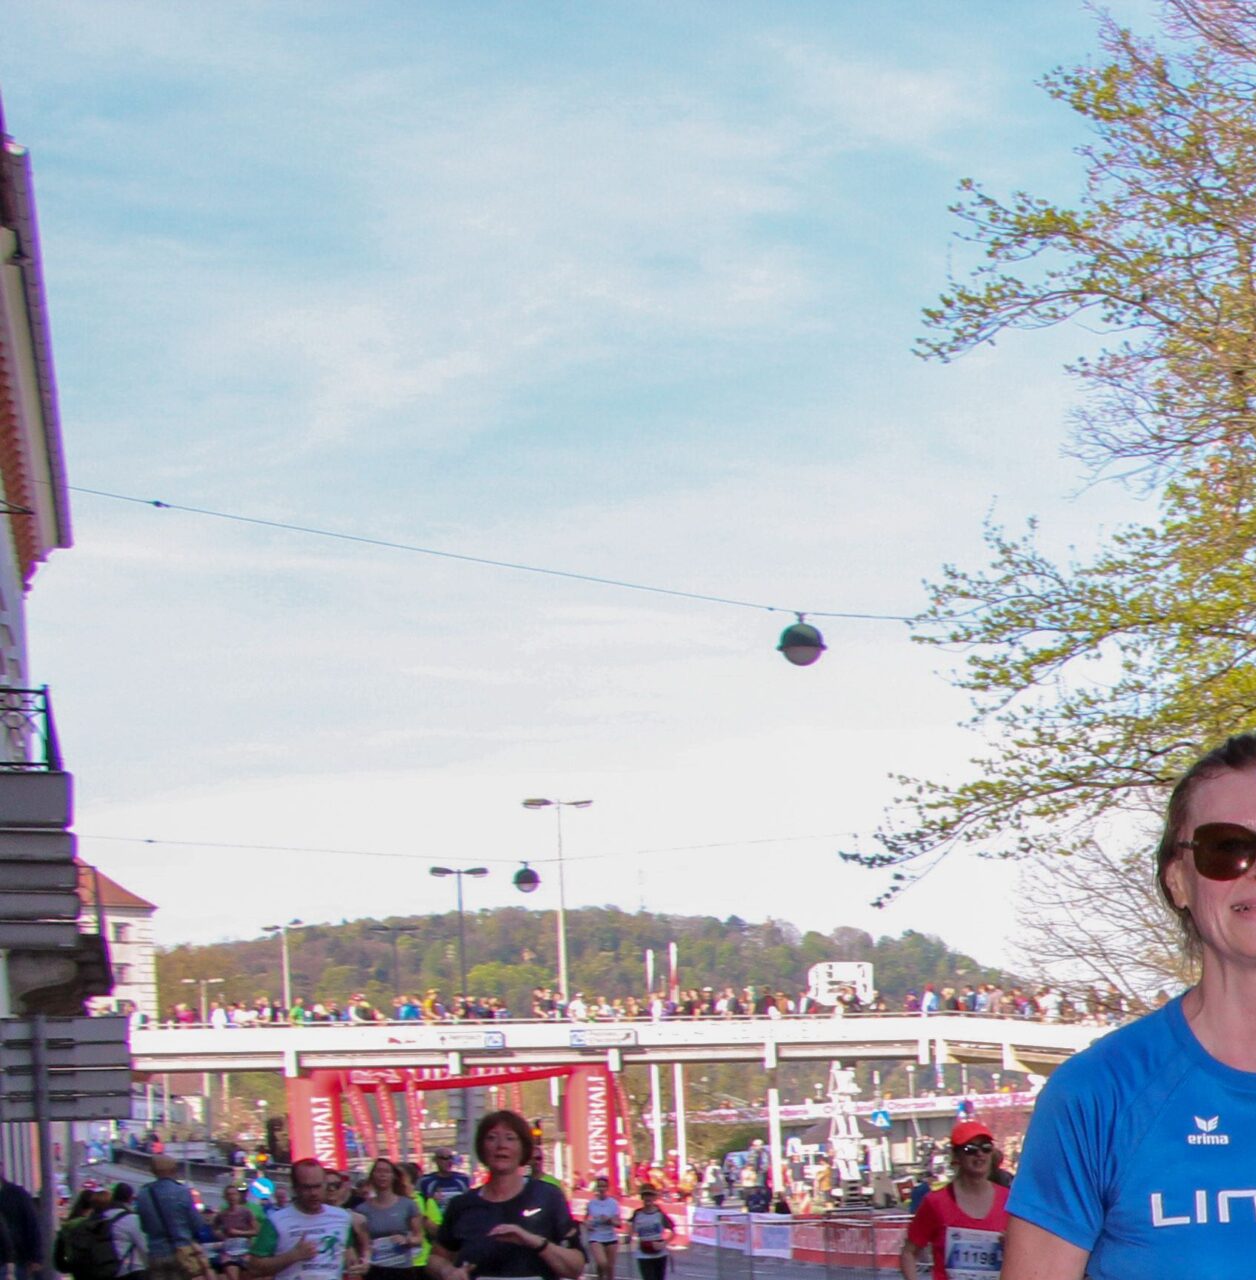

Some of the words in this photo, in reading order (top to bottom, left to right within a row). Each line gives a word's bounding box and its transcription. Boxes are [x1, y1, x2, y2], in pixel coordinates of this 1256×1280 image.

[310, 1096, 337, 1169] NERALI
[587, 1076, 609, 1164] GENERALI
[1188, 1133, 1229, 1145] erima
